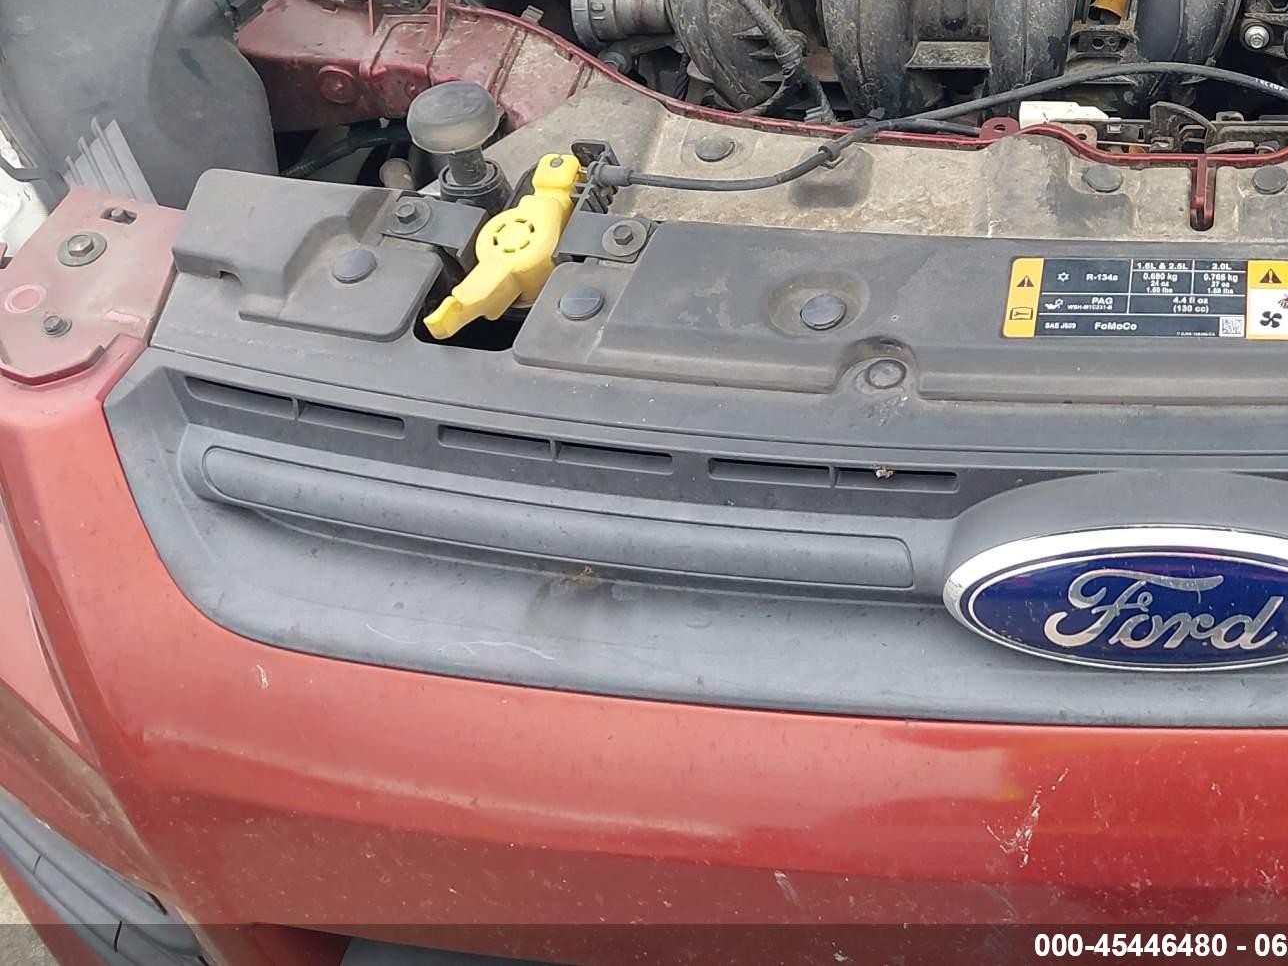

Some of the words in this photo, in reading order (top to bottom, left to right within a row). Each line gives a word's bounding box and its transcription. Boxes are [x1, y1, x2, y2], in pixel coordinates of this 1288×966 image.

[1158, 262, 1166, 270] &
[1211, 262, 1232, 270] 2.0L
[1086, 273, 1119, 281] R-134a
[1167, 273, 1178, 282] kg
[1227, 274, 1238, 283] kg
[1092, 297, 1113, 305] PAG
[1173, 305, 1193, 313] (130
[1194, 305, 1209, 313] cc)
[1094, 321, 1137, 331] FoMoCo
[1043, 568, 1285, 651] Ford
